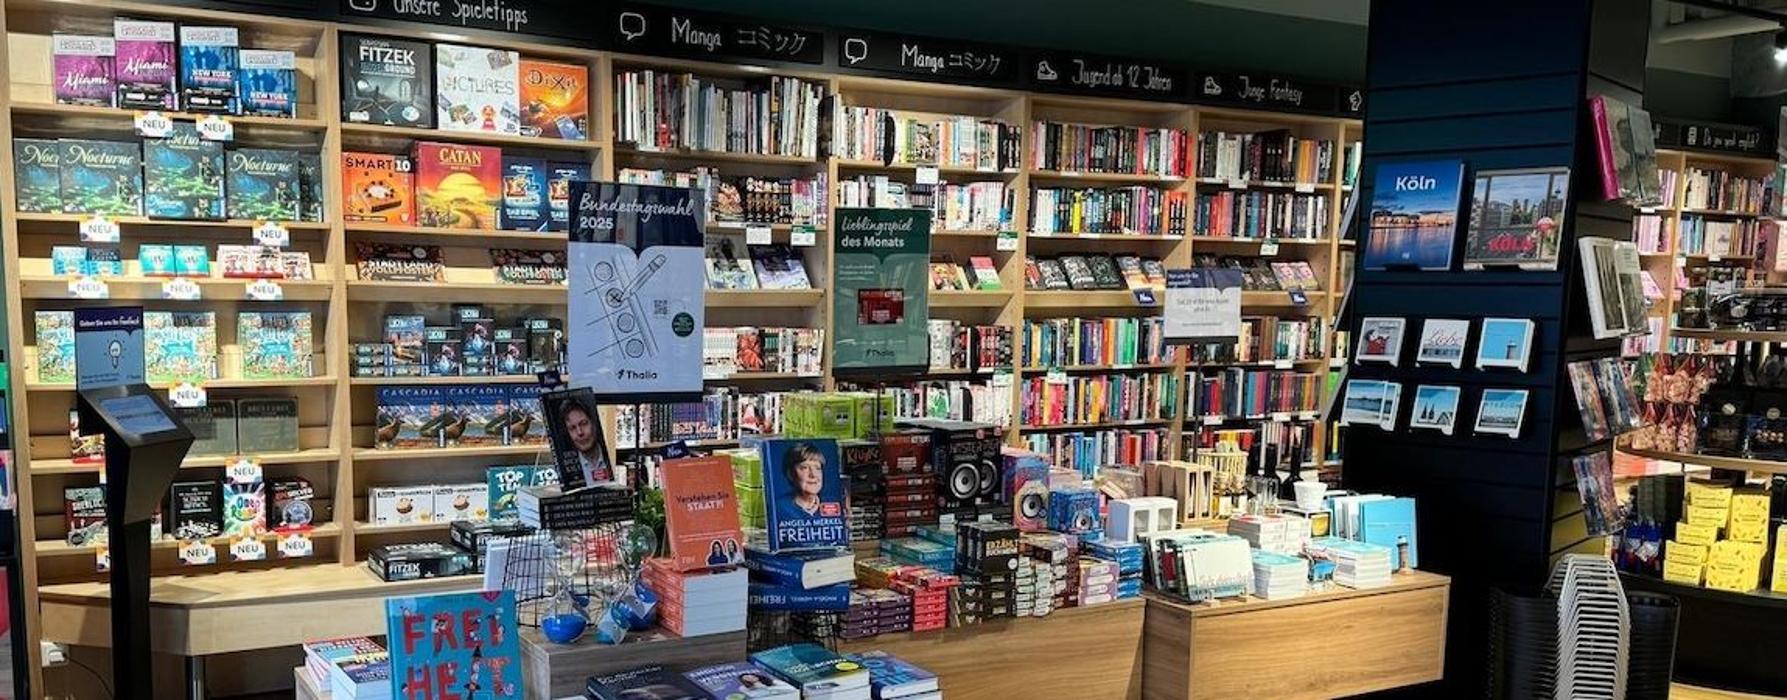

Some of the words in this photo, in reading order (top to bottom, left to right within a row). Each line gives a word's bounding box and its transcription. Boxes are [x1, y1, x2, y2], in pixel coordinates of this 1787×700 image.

[671, 16, 722, 52] Manga
[359, 45, 416, 66] FITZEK
[901, 43, 945, 73] Manga
[142, 118, 166, 130] NEU
[203, 122, 226, 132] NEU
[66, 145, 134, 165] Nocturne
[439, 147, 481, 165] CATAN
[230, 153, 294, 174] Nocturne
[345, 156, 393, 172] SMART
[394, 159, 412, 172] 10
[1395, 175, 1436, 191] Köln
[579, 192, 695, 223] Bundestagswahl
[88, 223, 112, 235] NEU
[579, 216, 614, 230] 2025
[260, 228, 282, 239] NEU
[841, 235, 861, 248] des
[864, 236, 905, 248] Monats
[76, 281, 101, 292] NEU
[169, 282, 194, 293] NEU
[253, 284, 276, 295] NEU
[627, 369, 658, 380] Thalia
[176, 390, 199, 401] NEU
[382, 388, 440, 397] CASCADIA
[450, 388, 504, 396] CASCADIA
[233, 467, 255, 477] NEU
[494, 470, 525, 484] TOP
[779, 525, 844, 542] FREIHEIT
[237, 543, 259, 553] NEU
[285, 541, 306, 550] NEU
[187, 548, 209, 558] NEU
[403, 607, 504, 656] FREI
